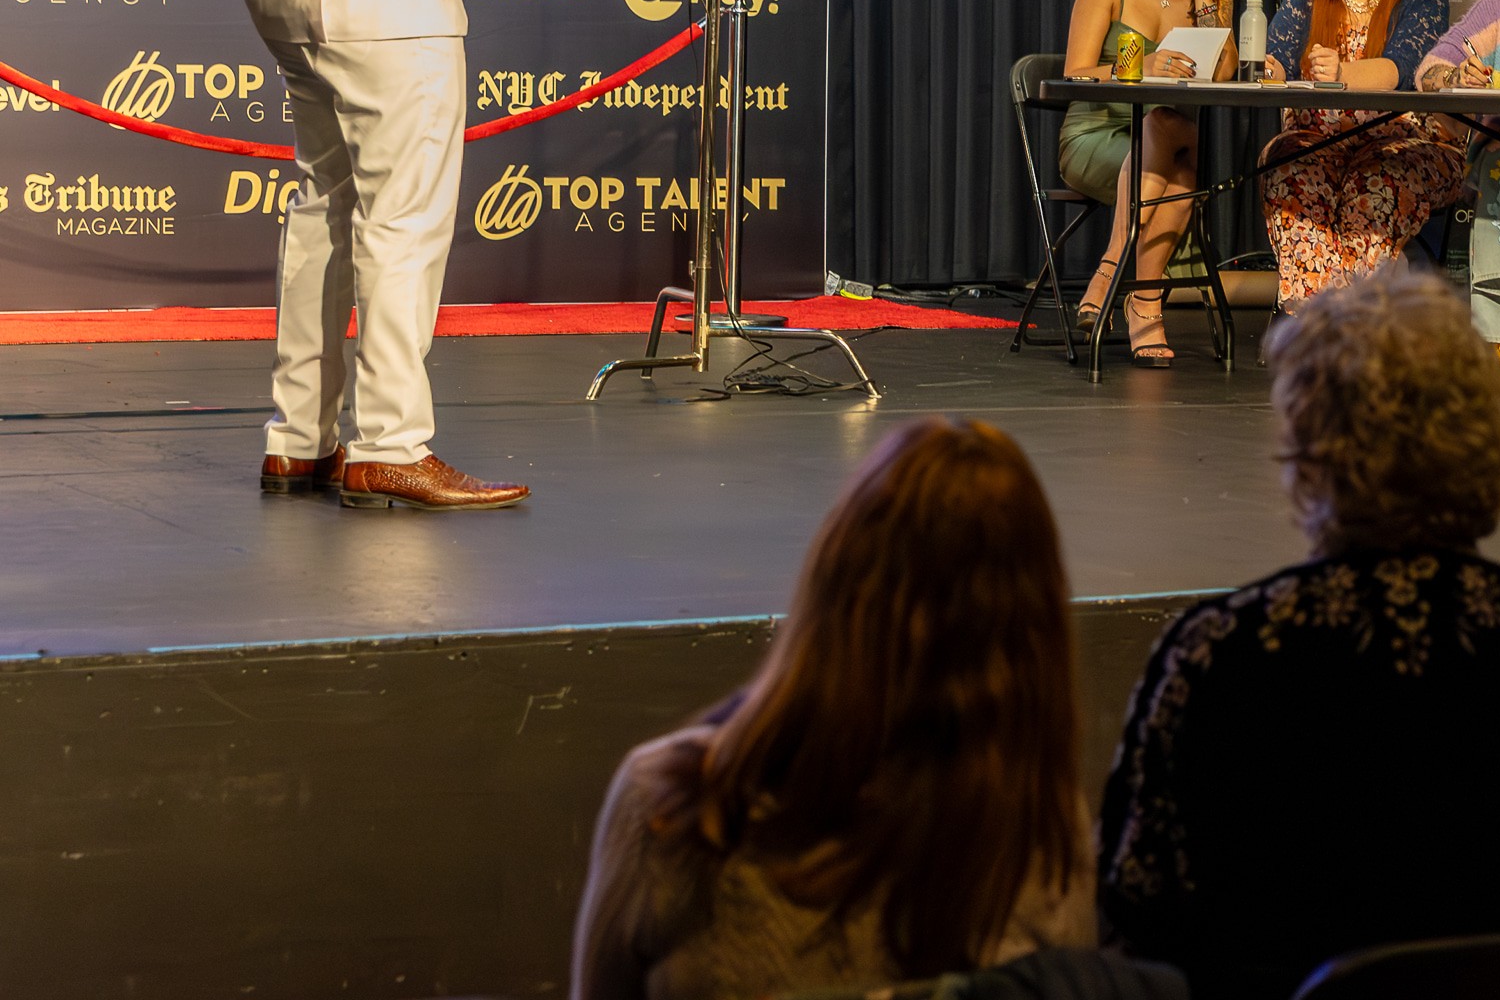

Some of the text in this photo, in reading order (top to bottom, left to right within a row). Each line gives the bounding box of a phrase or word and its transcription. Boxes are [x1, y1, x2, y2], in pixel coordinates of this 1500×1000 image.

[176, 64, 264, 99] TOP
[476, 70, 566, 115] NYC
[210, 101, 293, 124] AGE
[24, 173, 177, 213] Tribune
[543, 177, 625, 211] TOP
[57, 217, 175, 236] MAGAZINE
